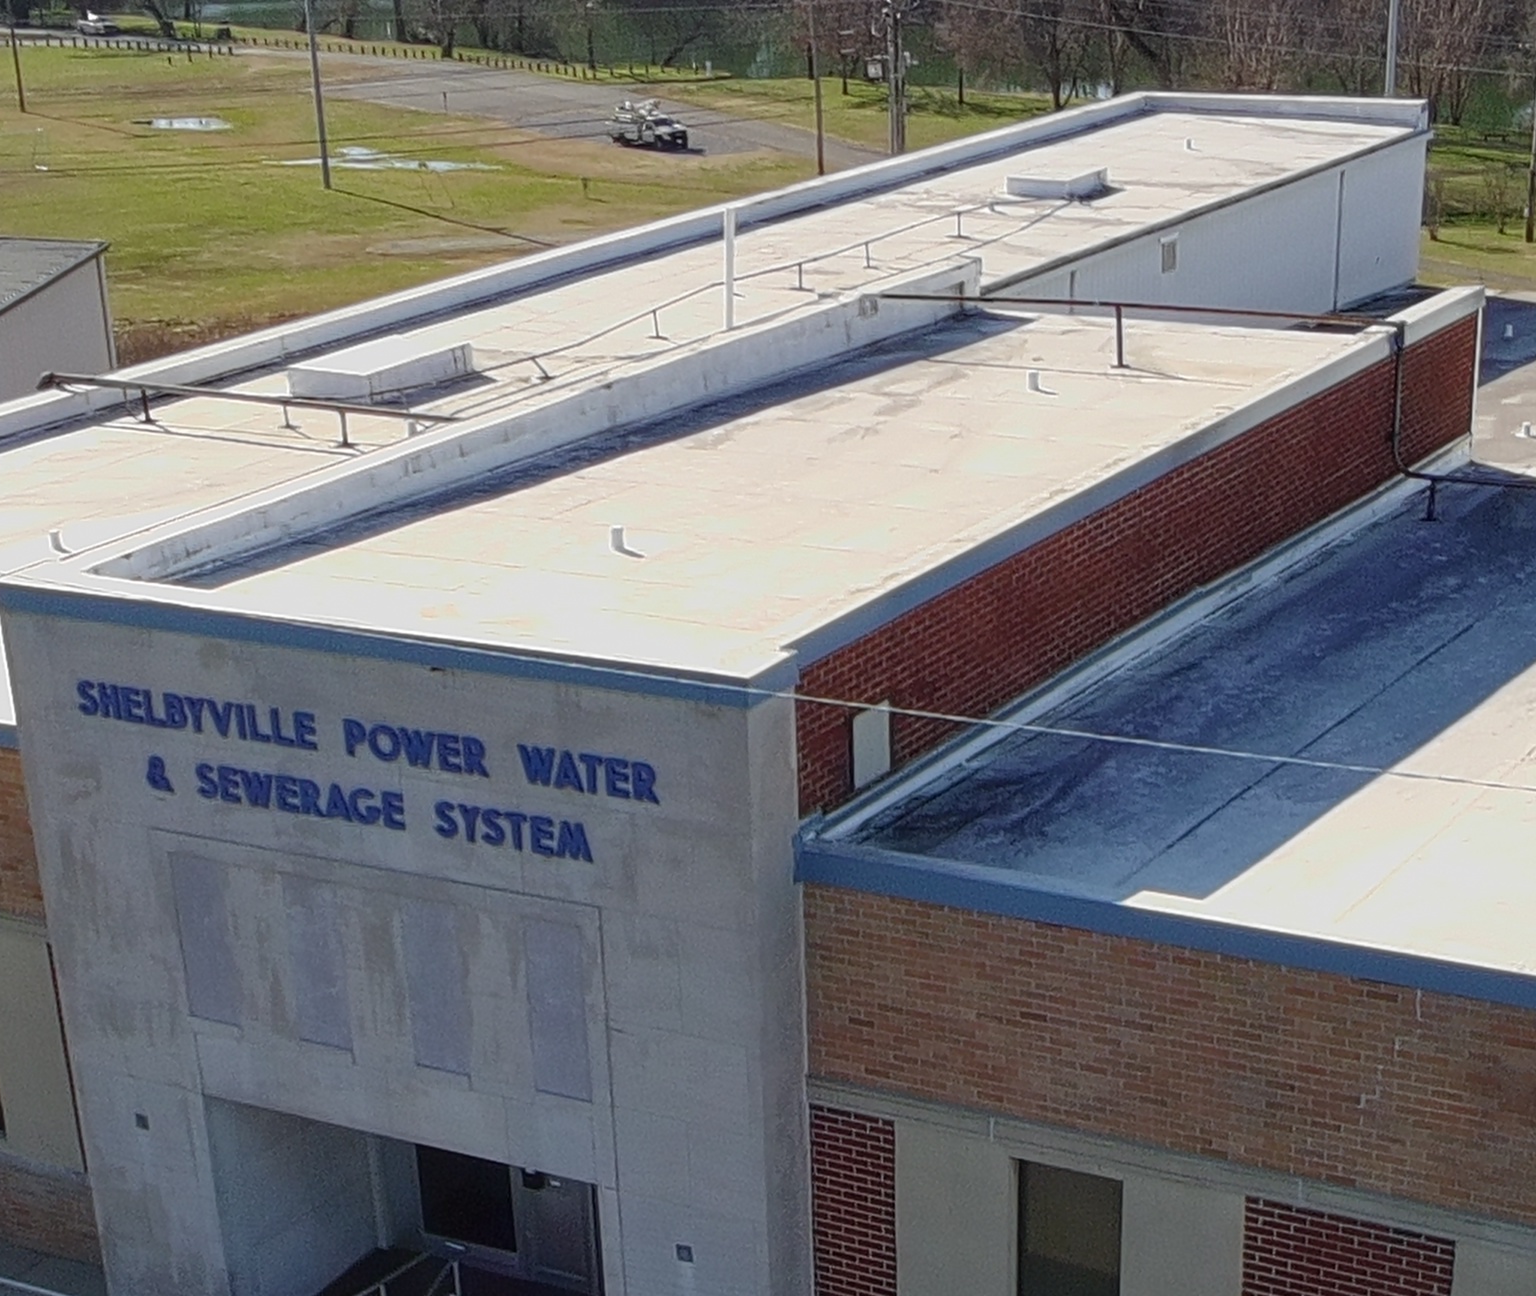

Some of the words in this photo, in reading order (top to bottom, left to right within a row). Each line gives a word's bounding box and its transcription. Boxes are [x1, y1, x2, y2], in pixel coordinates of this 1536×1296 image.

[77, 679, 319, 751] SHELBYVILLE
[343, 718, 489, 779] POWER
[517, 743, 661, 805] WATER
[146, 755, 174, 794] &
[195, 762, 407, 831] SEWERAGE
[435, 800, 594, 863] SYSTEM
